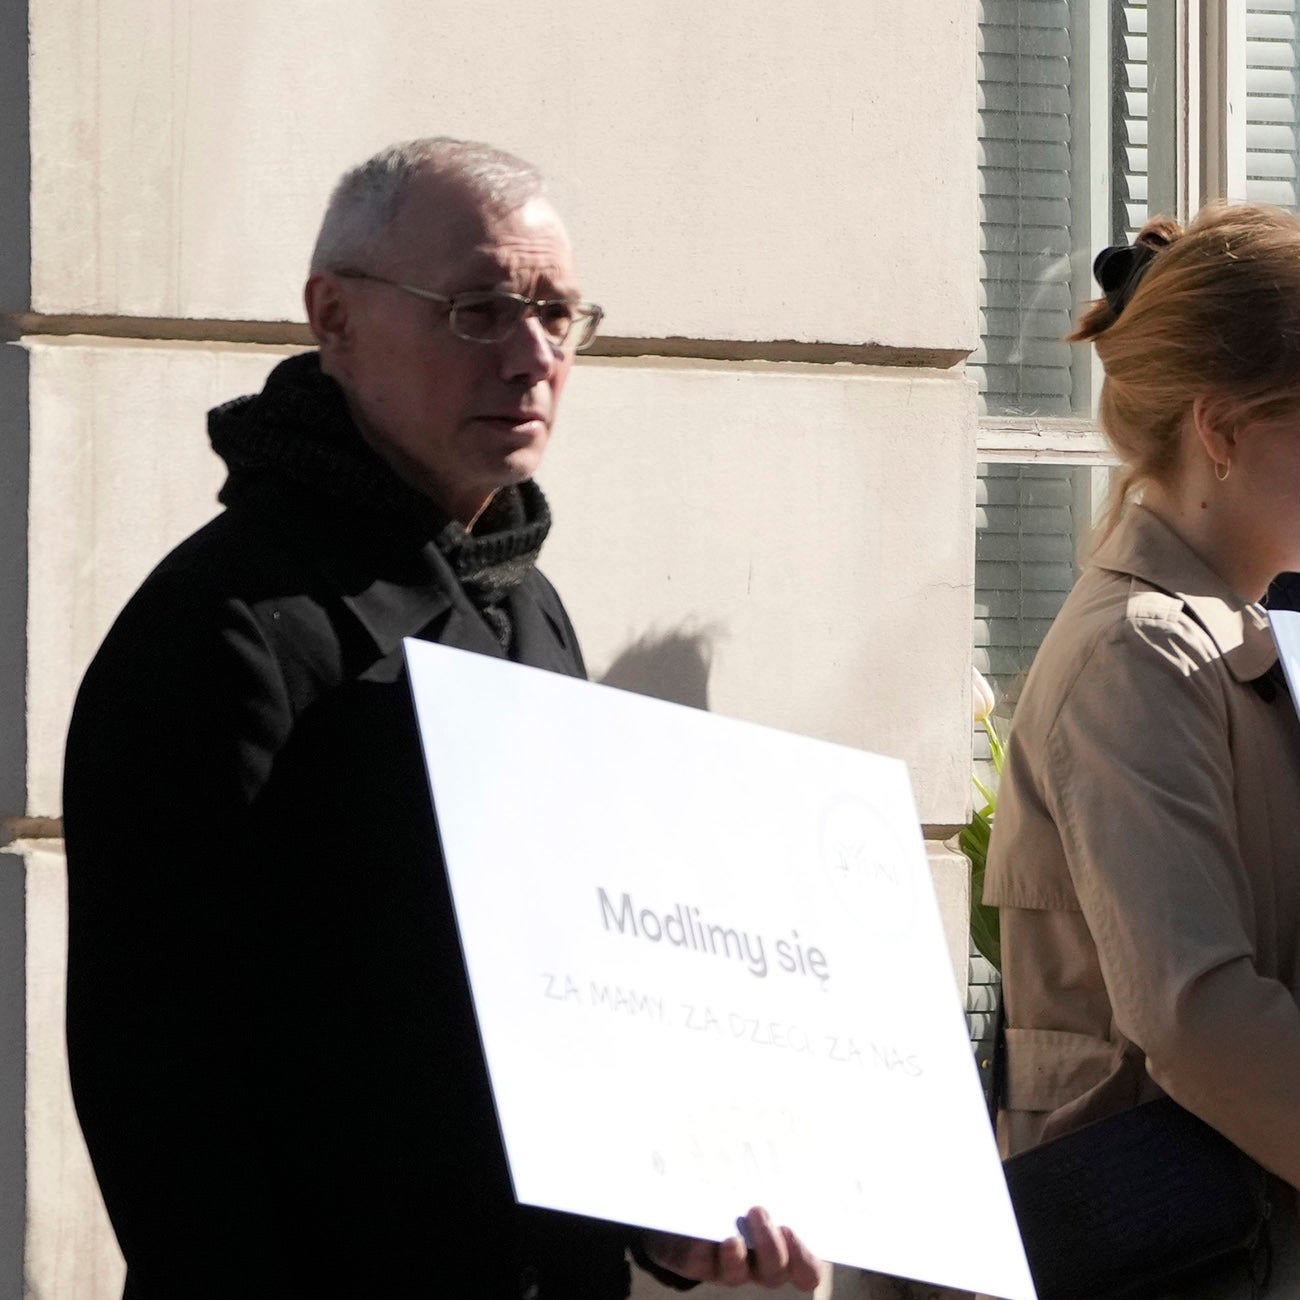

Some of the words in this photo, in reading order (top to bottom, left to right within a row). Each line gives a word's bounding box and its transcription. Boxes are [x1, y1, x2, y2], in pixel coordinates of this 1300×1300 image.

[597, 886, 769, 978] Modlimy
[774, 928, 831, 992] się
[540, 971, 581, 1004] ZA
[590, 980, 666, 1019] MAMY
[681, 1003, 721, 1032] ZA
